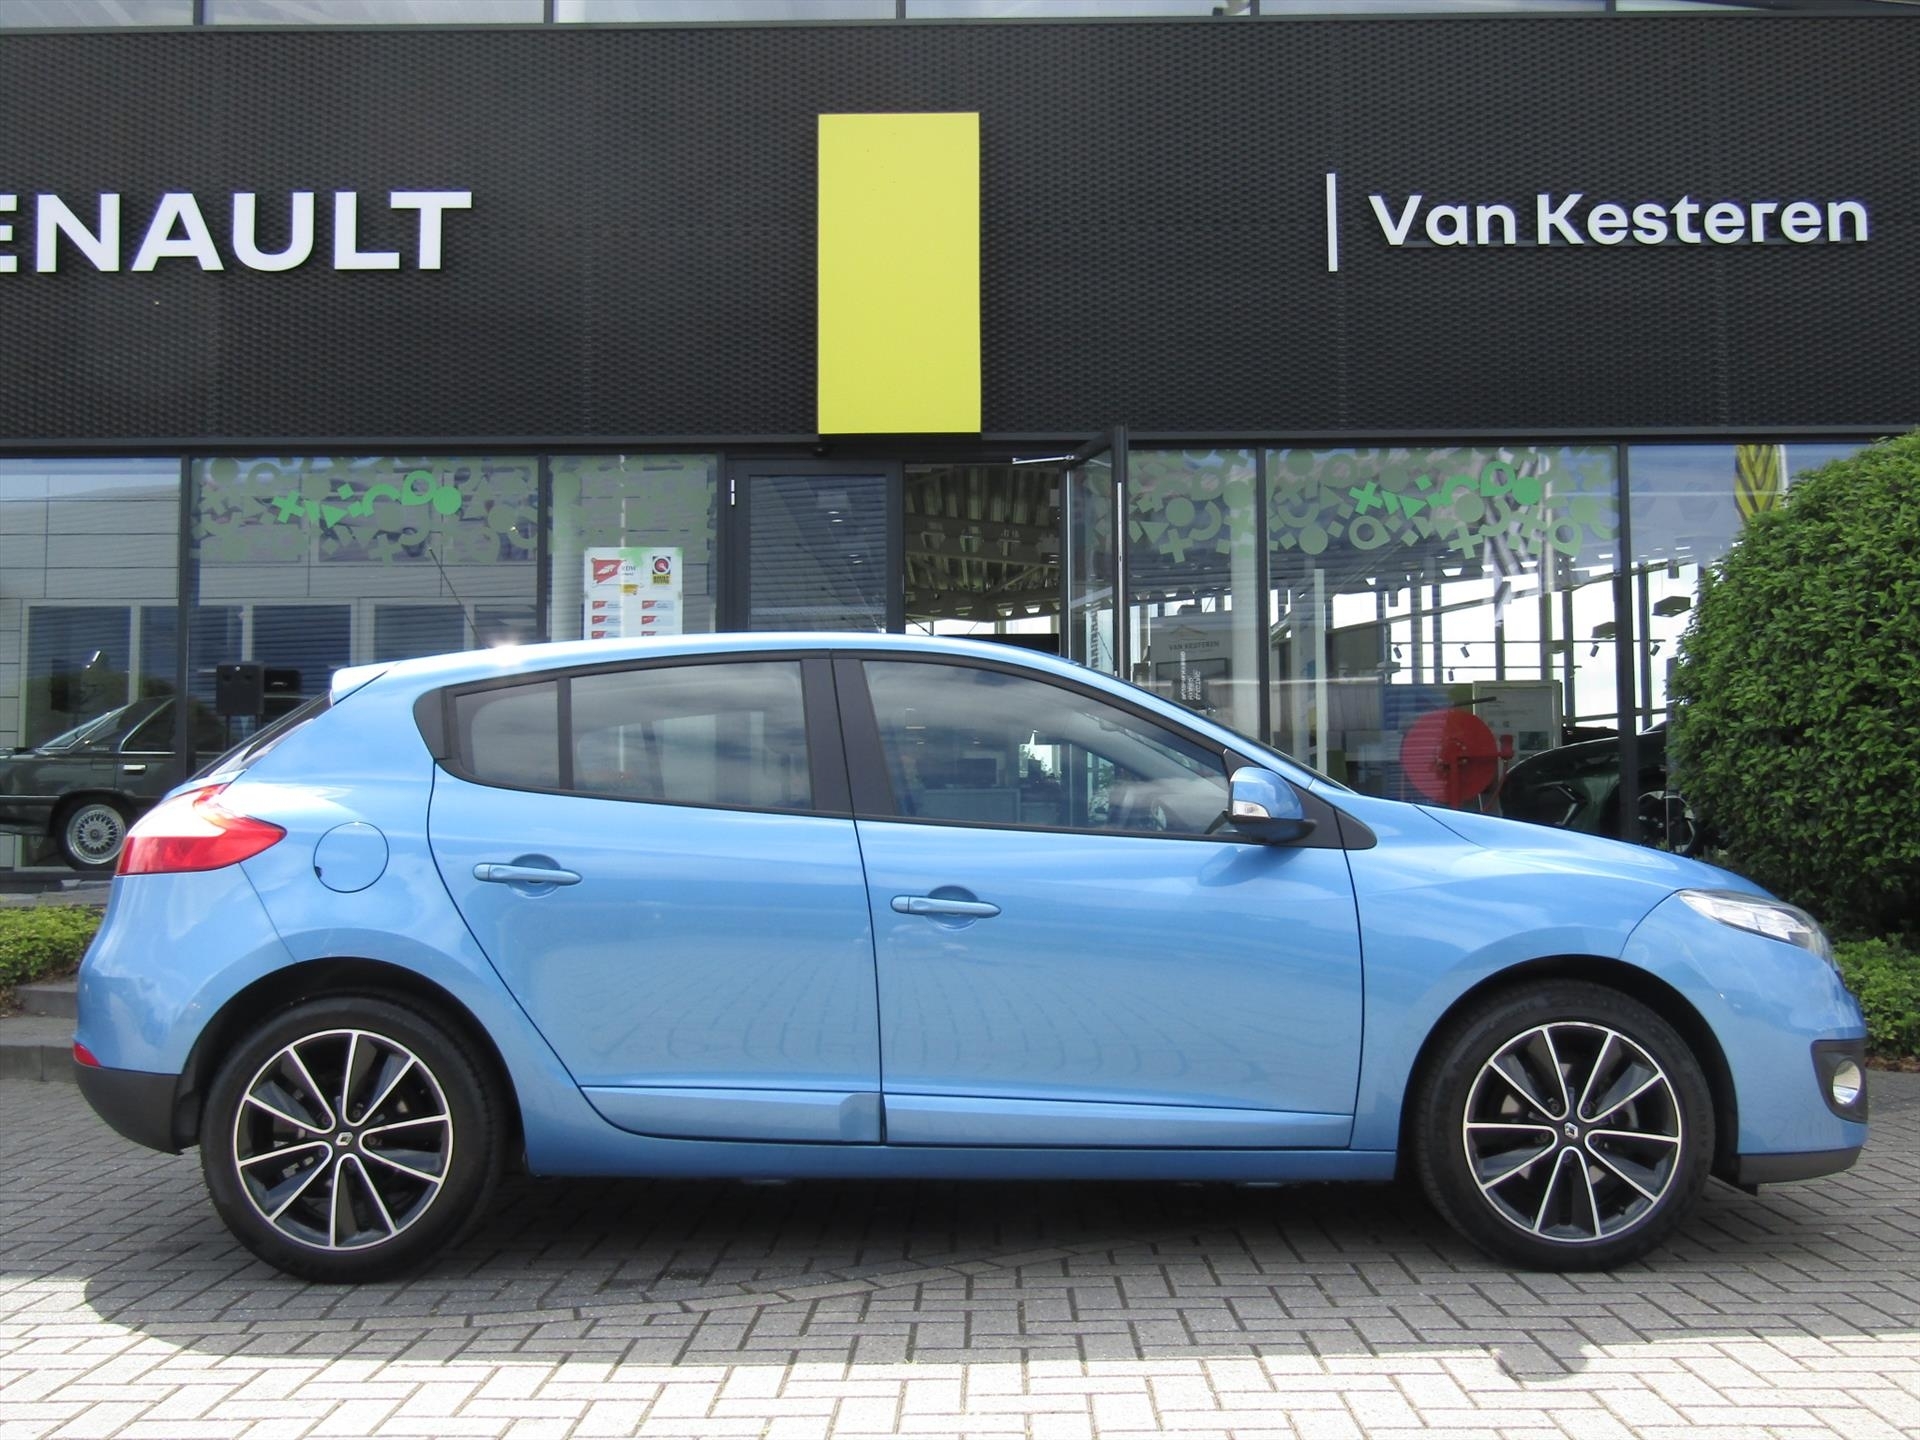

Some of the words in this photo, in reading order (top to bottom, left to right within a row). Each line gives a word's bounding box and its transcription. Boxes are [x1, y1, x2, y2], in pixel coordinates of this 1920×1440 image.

[0, 191, 472, 273] NAULT
[1368, 193, 1517, 246] Van
[1536, 192, 1869, 246] Kesteren
